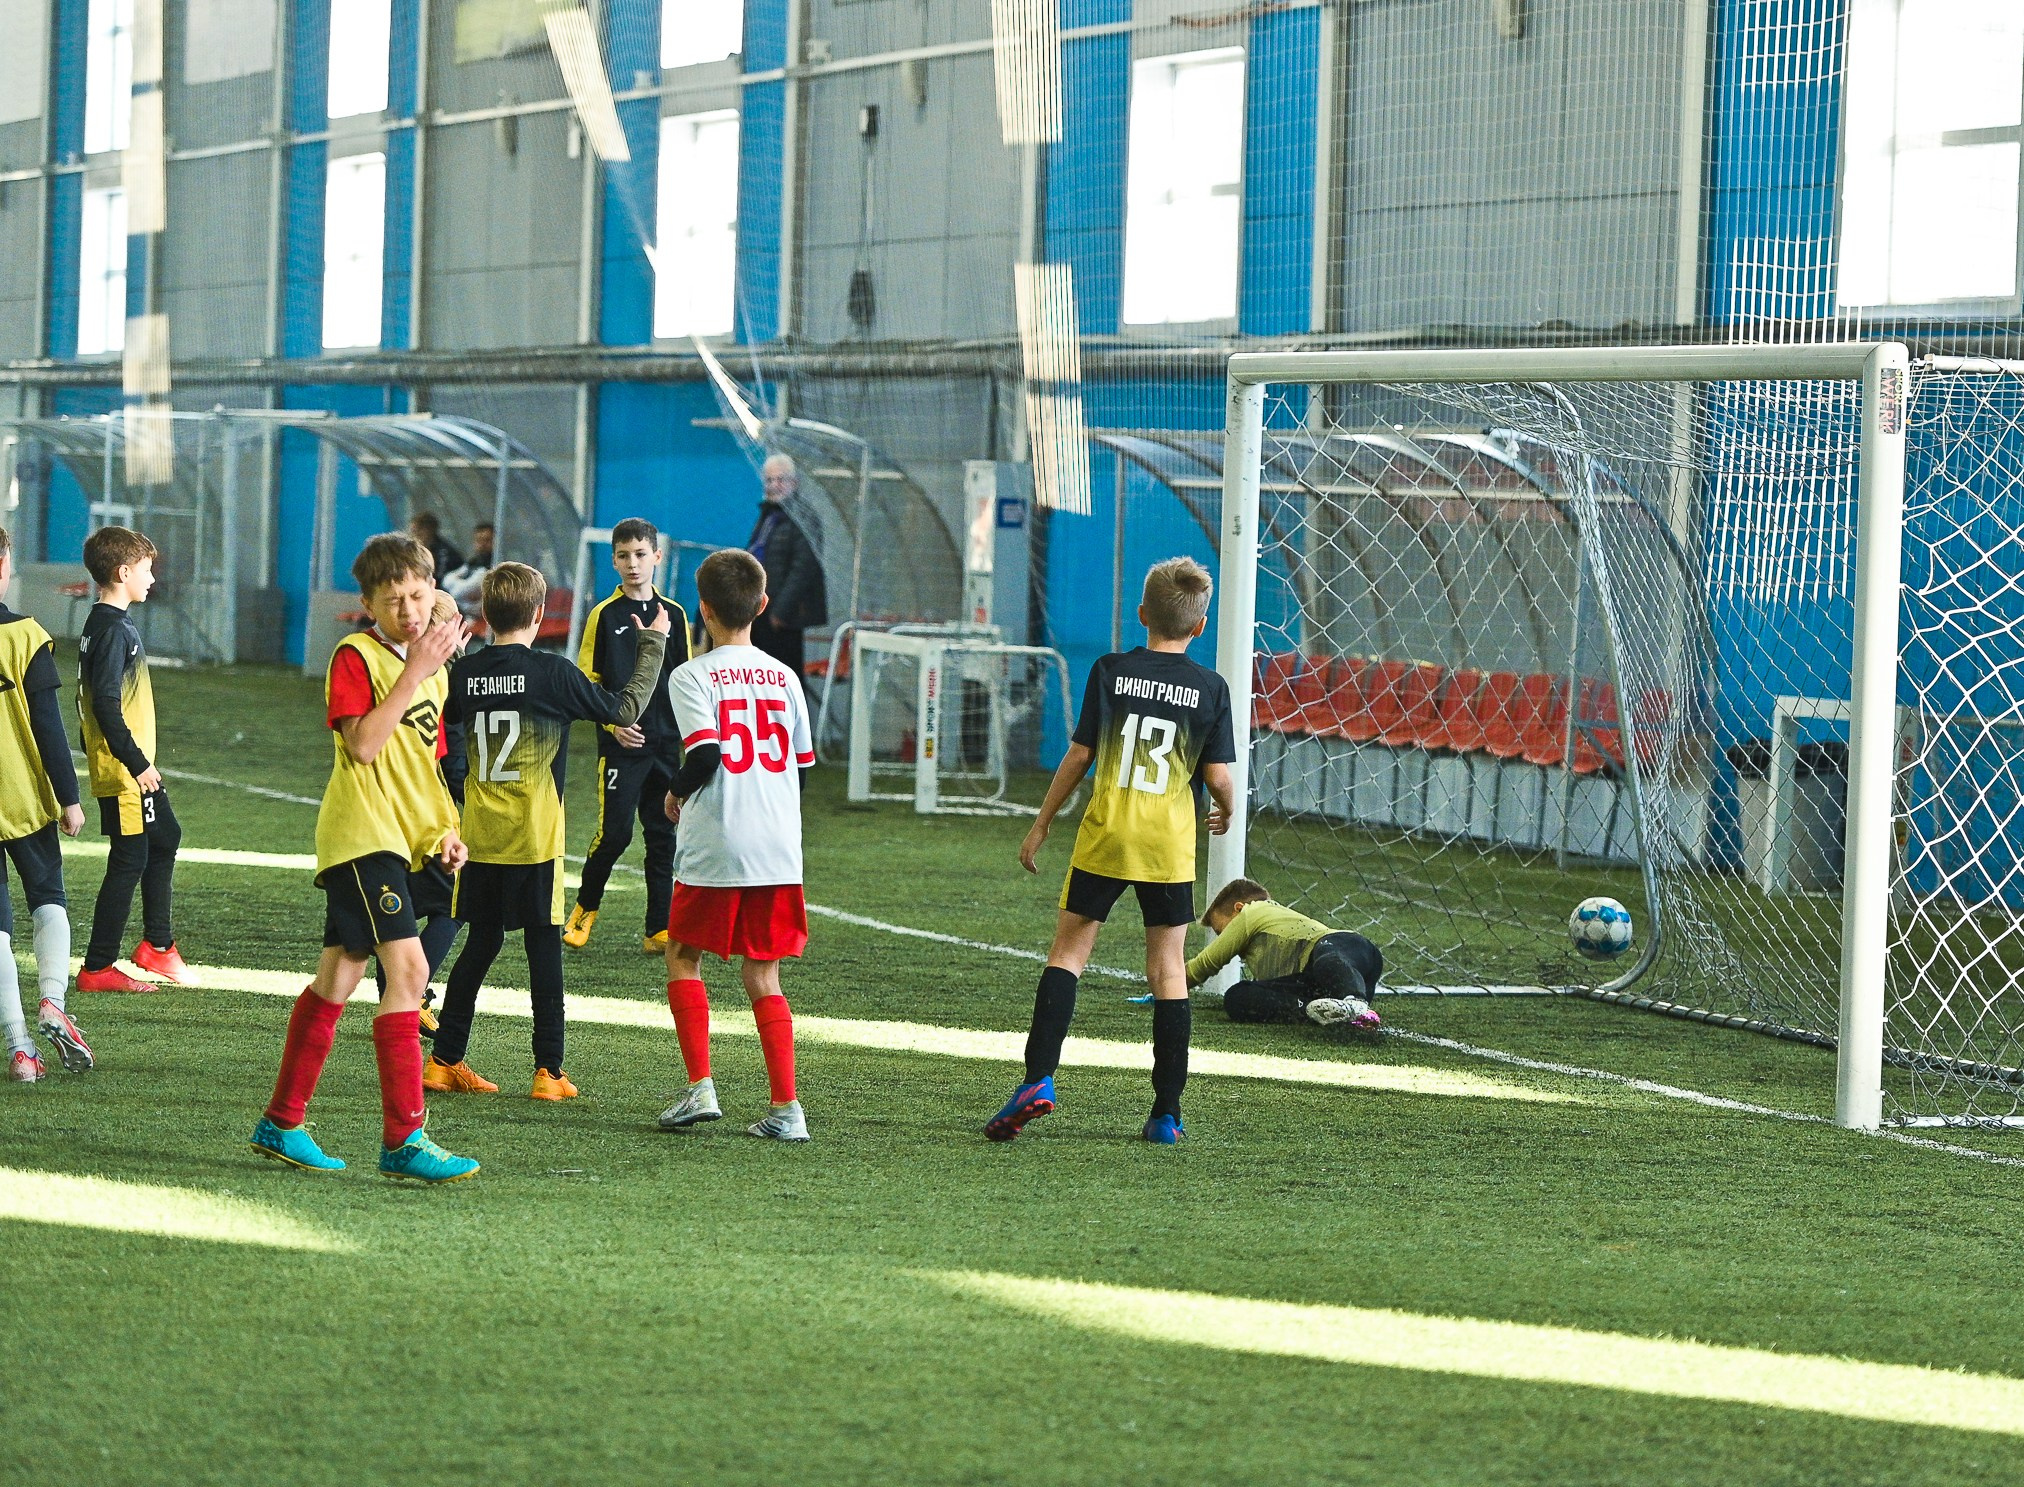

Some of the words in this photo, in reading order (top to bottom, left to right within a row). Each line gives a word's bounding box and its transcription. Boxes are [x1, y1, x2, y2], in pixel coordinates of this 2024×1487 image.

[1880, 377, 1895, 433] WERK
[467, 674, 525, 695] РЕЗАНЦЕВ
[709, 668, 787, 688] РЕМИЗОВ
[1114, 676, 1200, 709] ВИНОГРАДОВ
[474, 710, 520, 782] 12
[719, 699, 789, 774] 55
[1118, 713, 1177, 795] 13
[607, 768, 619, 790] 2
[144, 796, 156, 823] 3
